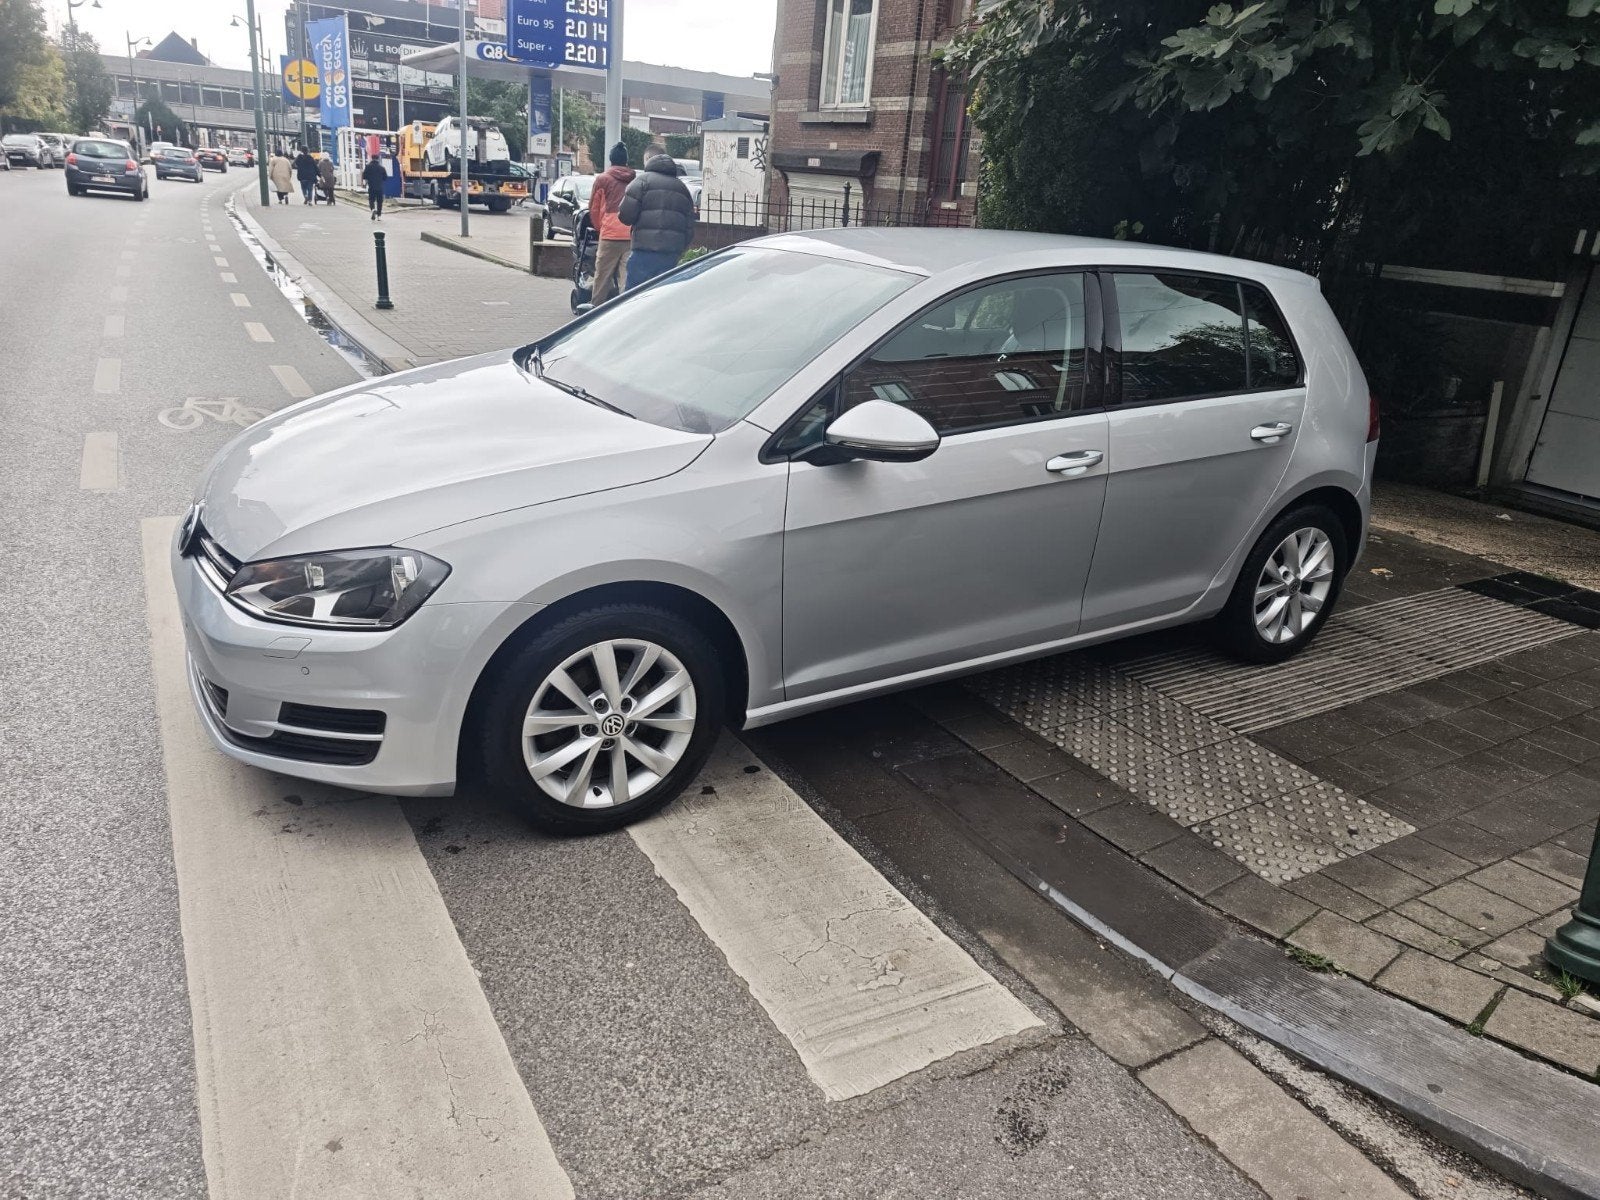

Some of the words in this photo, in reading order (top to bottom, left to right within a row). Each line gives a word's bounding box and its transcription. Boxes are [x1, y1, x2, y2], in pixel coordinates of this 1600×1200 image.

[517, 15, 540, 27] Euro
[543, 19, 555, 30] 95
[373, 43, 384, 53] LE
[482, 44, 503, 60] Q8
[517, 38, 546, 52] Super
